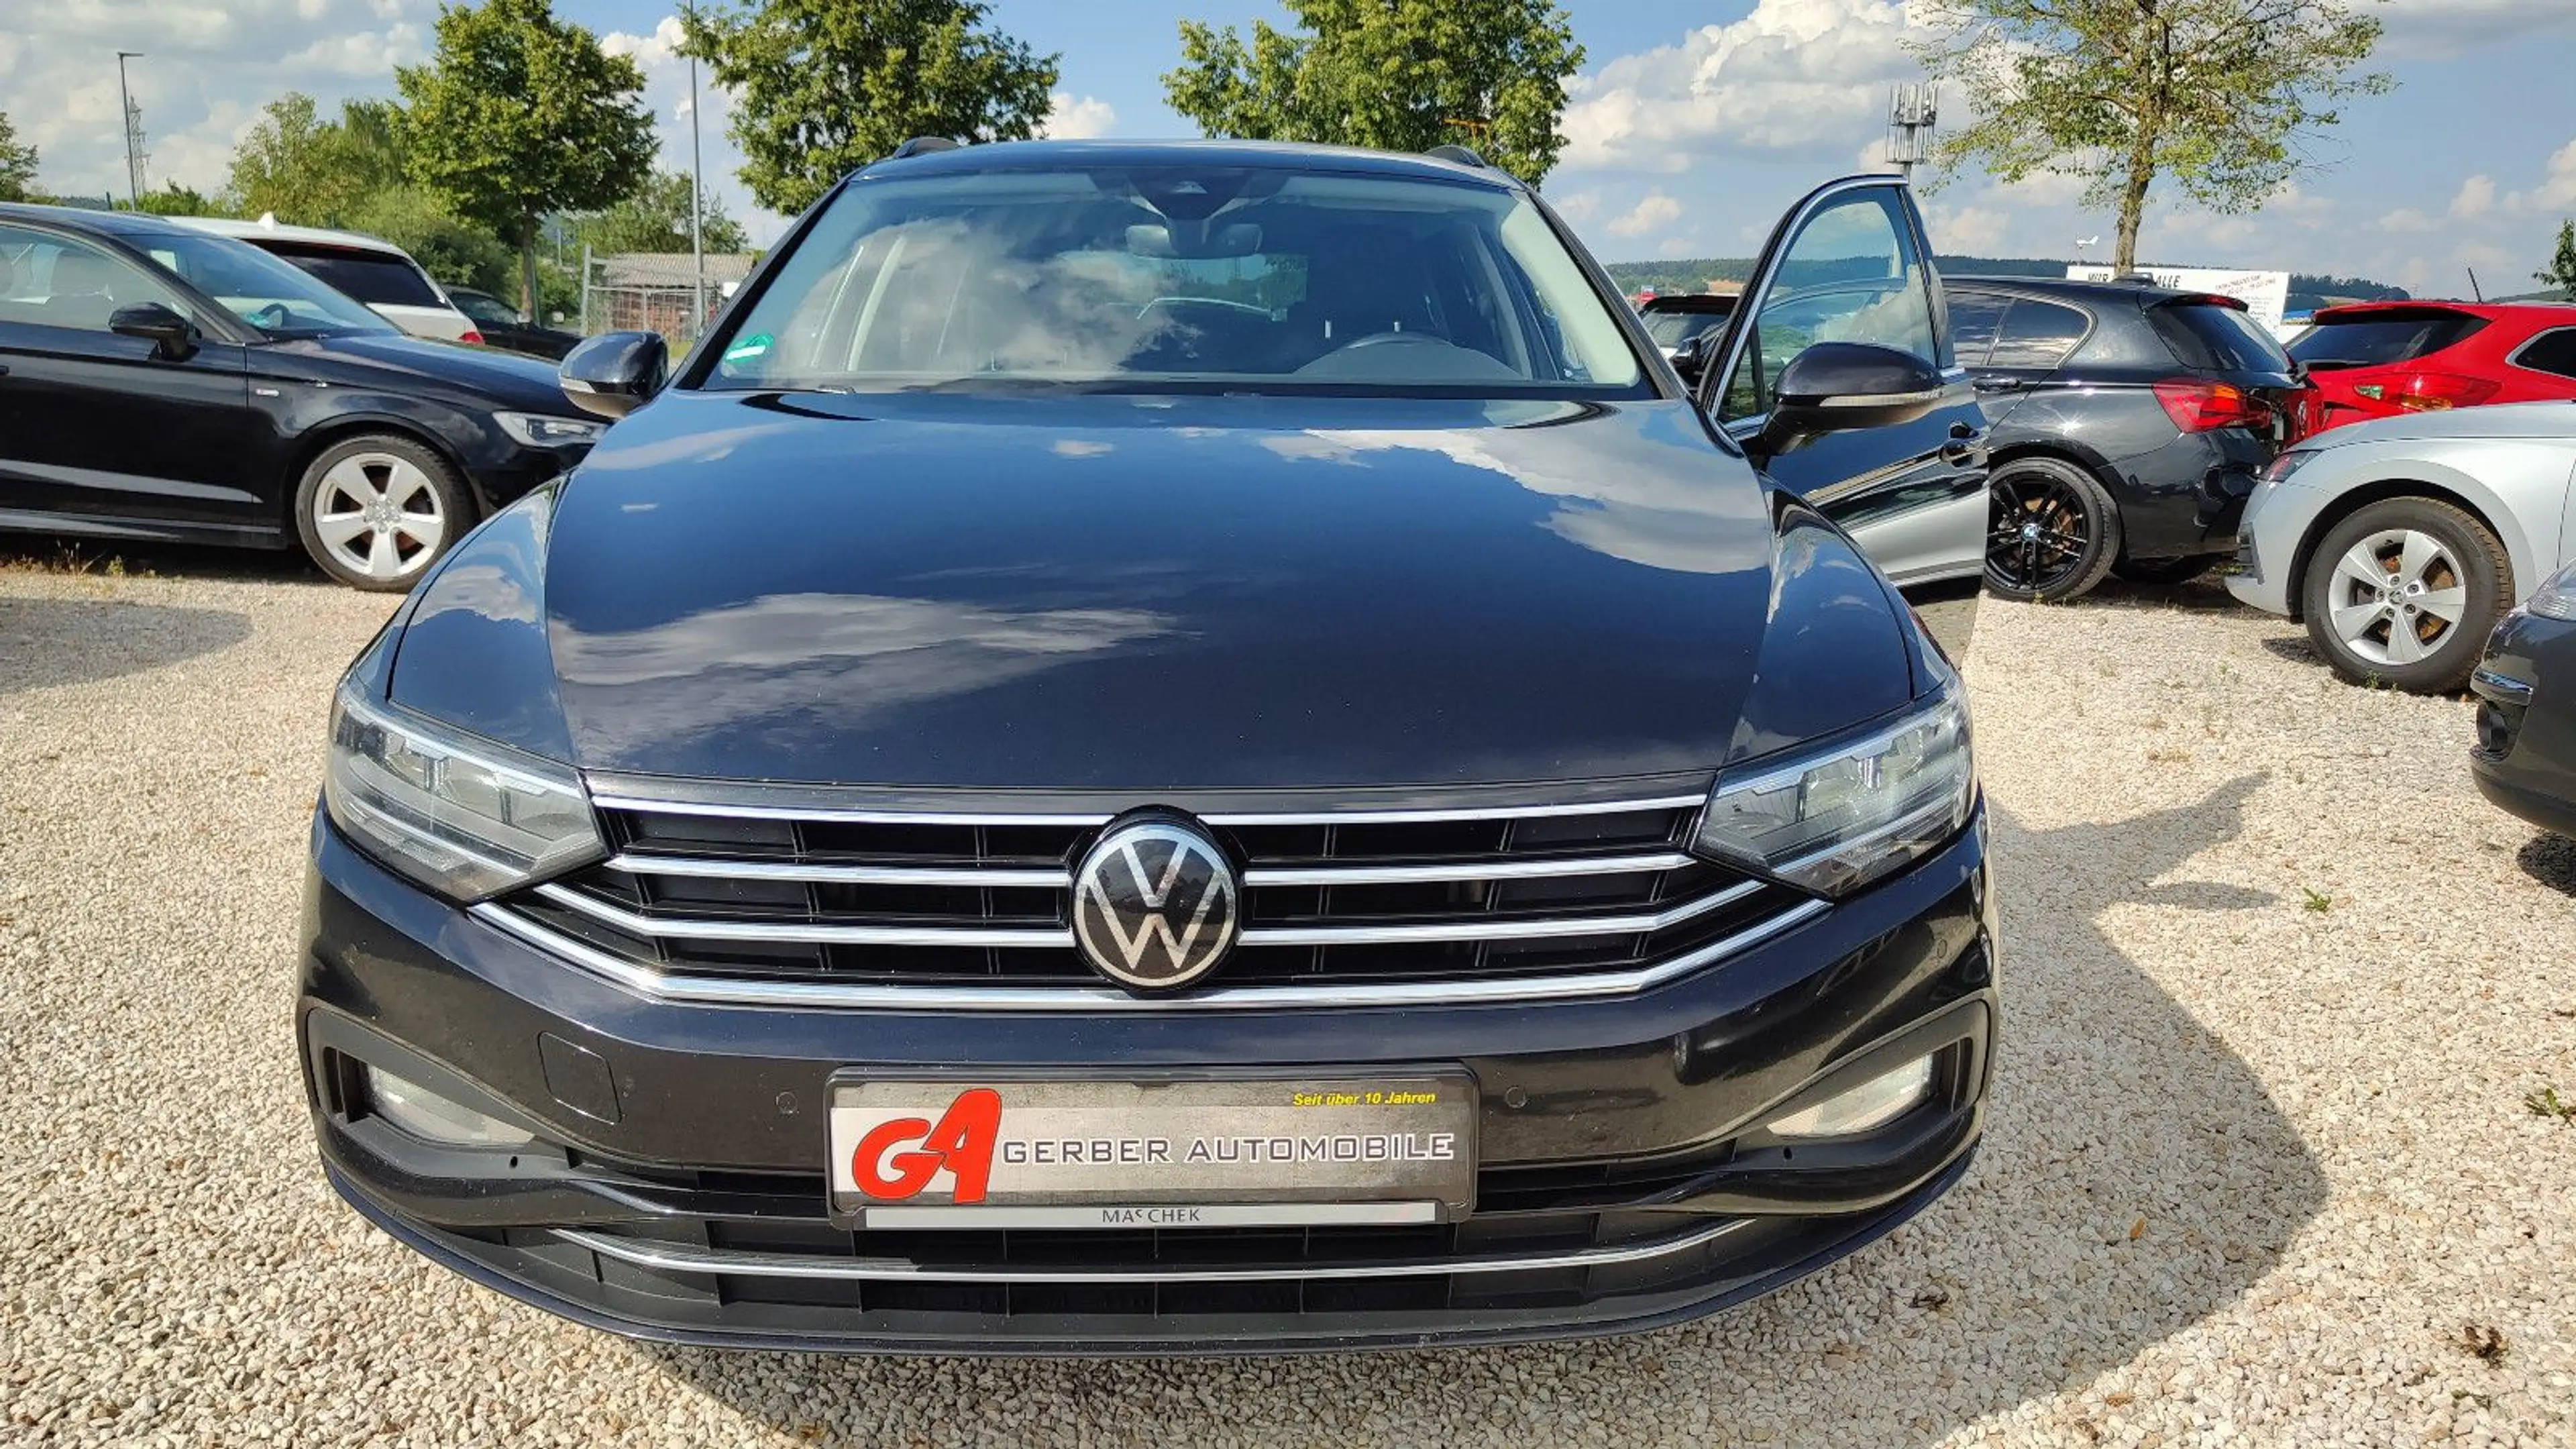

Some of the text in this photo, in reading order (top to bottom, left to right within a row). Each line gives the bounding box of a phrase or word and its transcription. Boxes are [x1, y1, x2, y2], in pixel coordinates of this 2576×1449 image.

[1080, 832, 1229, 974] VW
[1293, 1091, 1436, 1106] Seit über 10 Jahren
[851, 1087, 1003, 1205] GA
[1002, 1133, 1456, 1165] GERBER AUTOMOBILE
